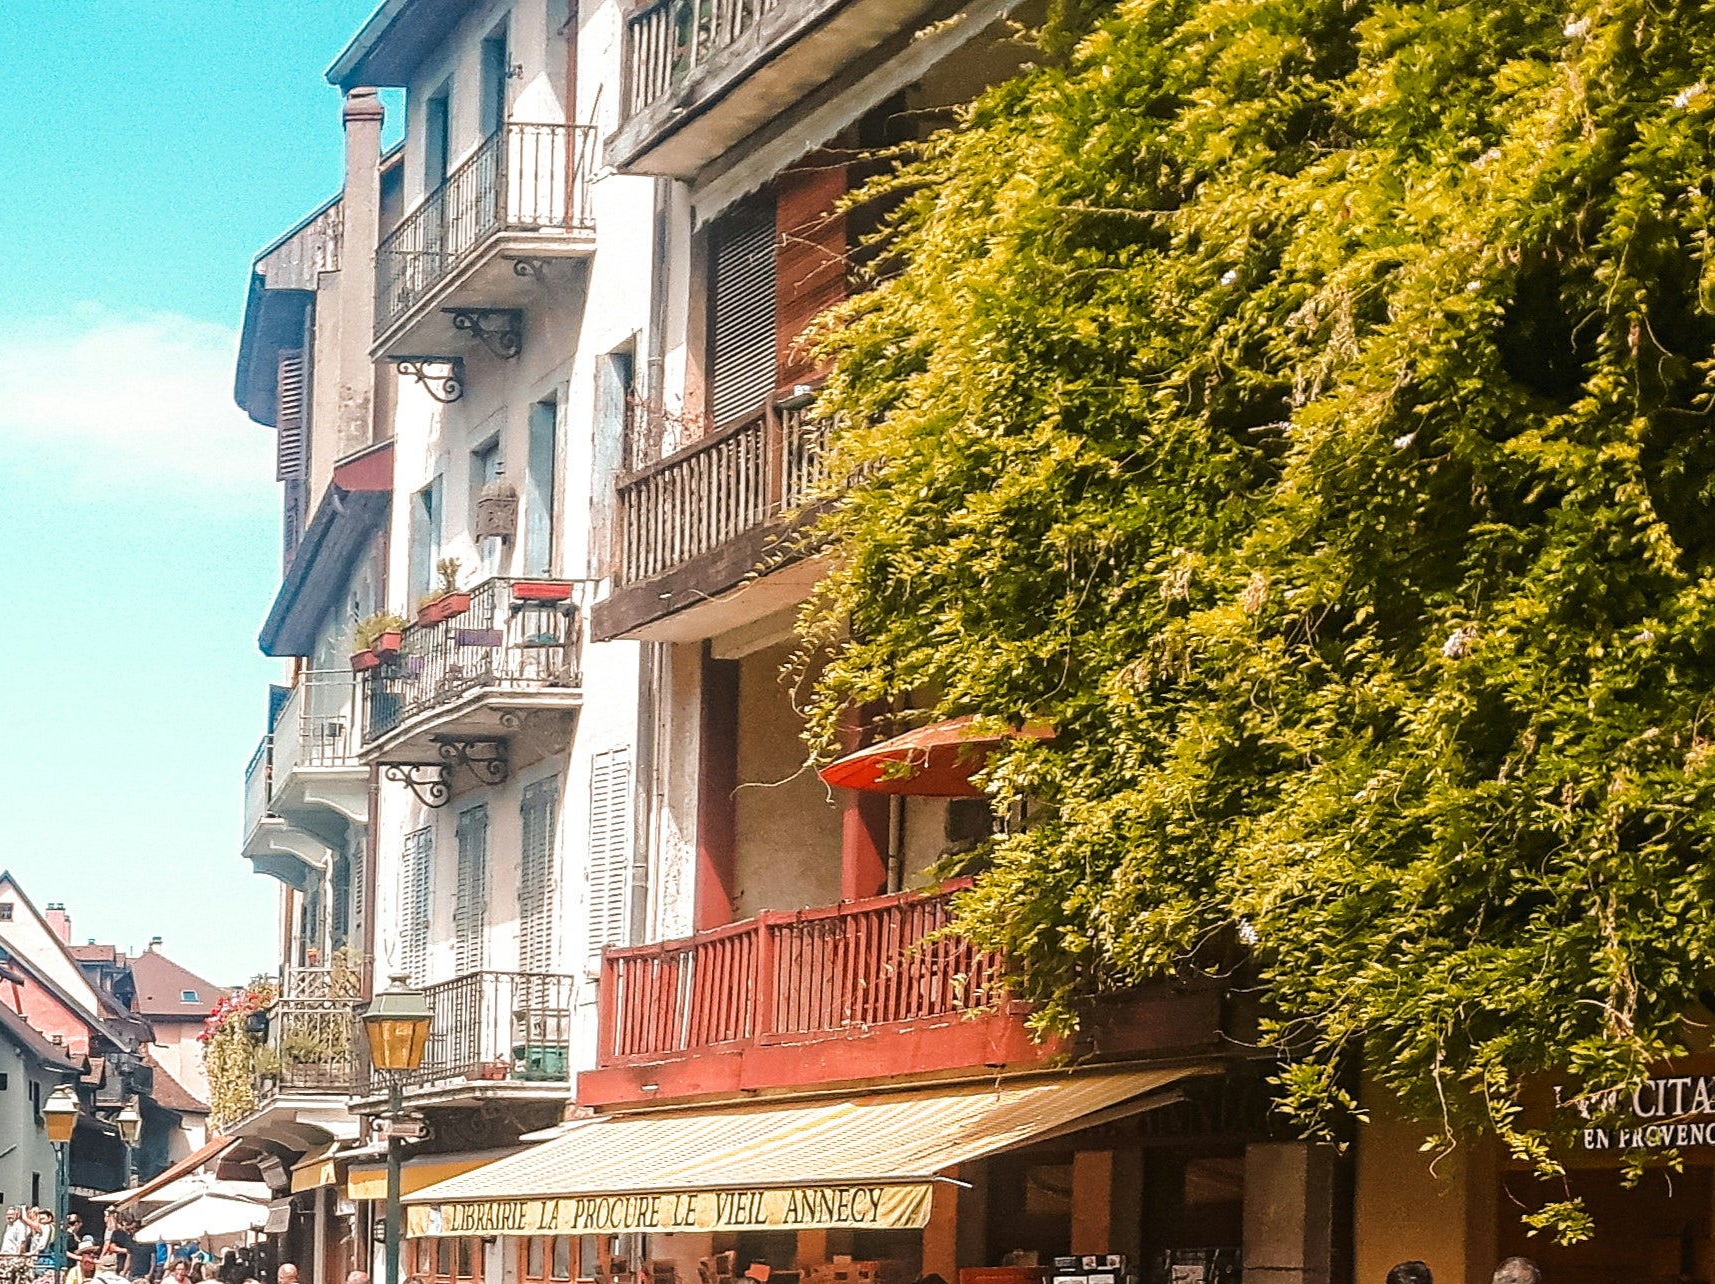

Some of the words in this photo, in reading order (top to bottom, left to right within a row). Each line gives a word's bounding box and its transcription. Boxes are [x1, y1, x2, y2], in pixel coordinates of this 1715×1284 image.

[1583, 1128, 1609, 1149] EN
[450, 1201, 529, 1232] LIBRAIRIE
[536, 1199, 560, 1230] LA
[570, 1195, 662, 1230] PROCURE
[671, 1193, 699, 1226] LE
[714, 1190, 769, 1226] VIEIL
[782, 1187, 885, 1224] ANNECY
